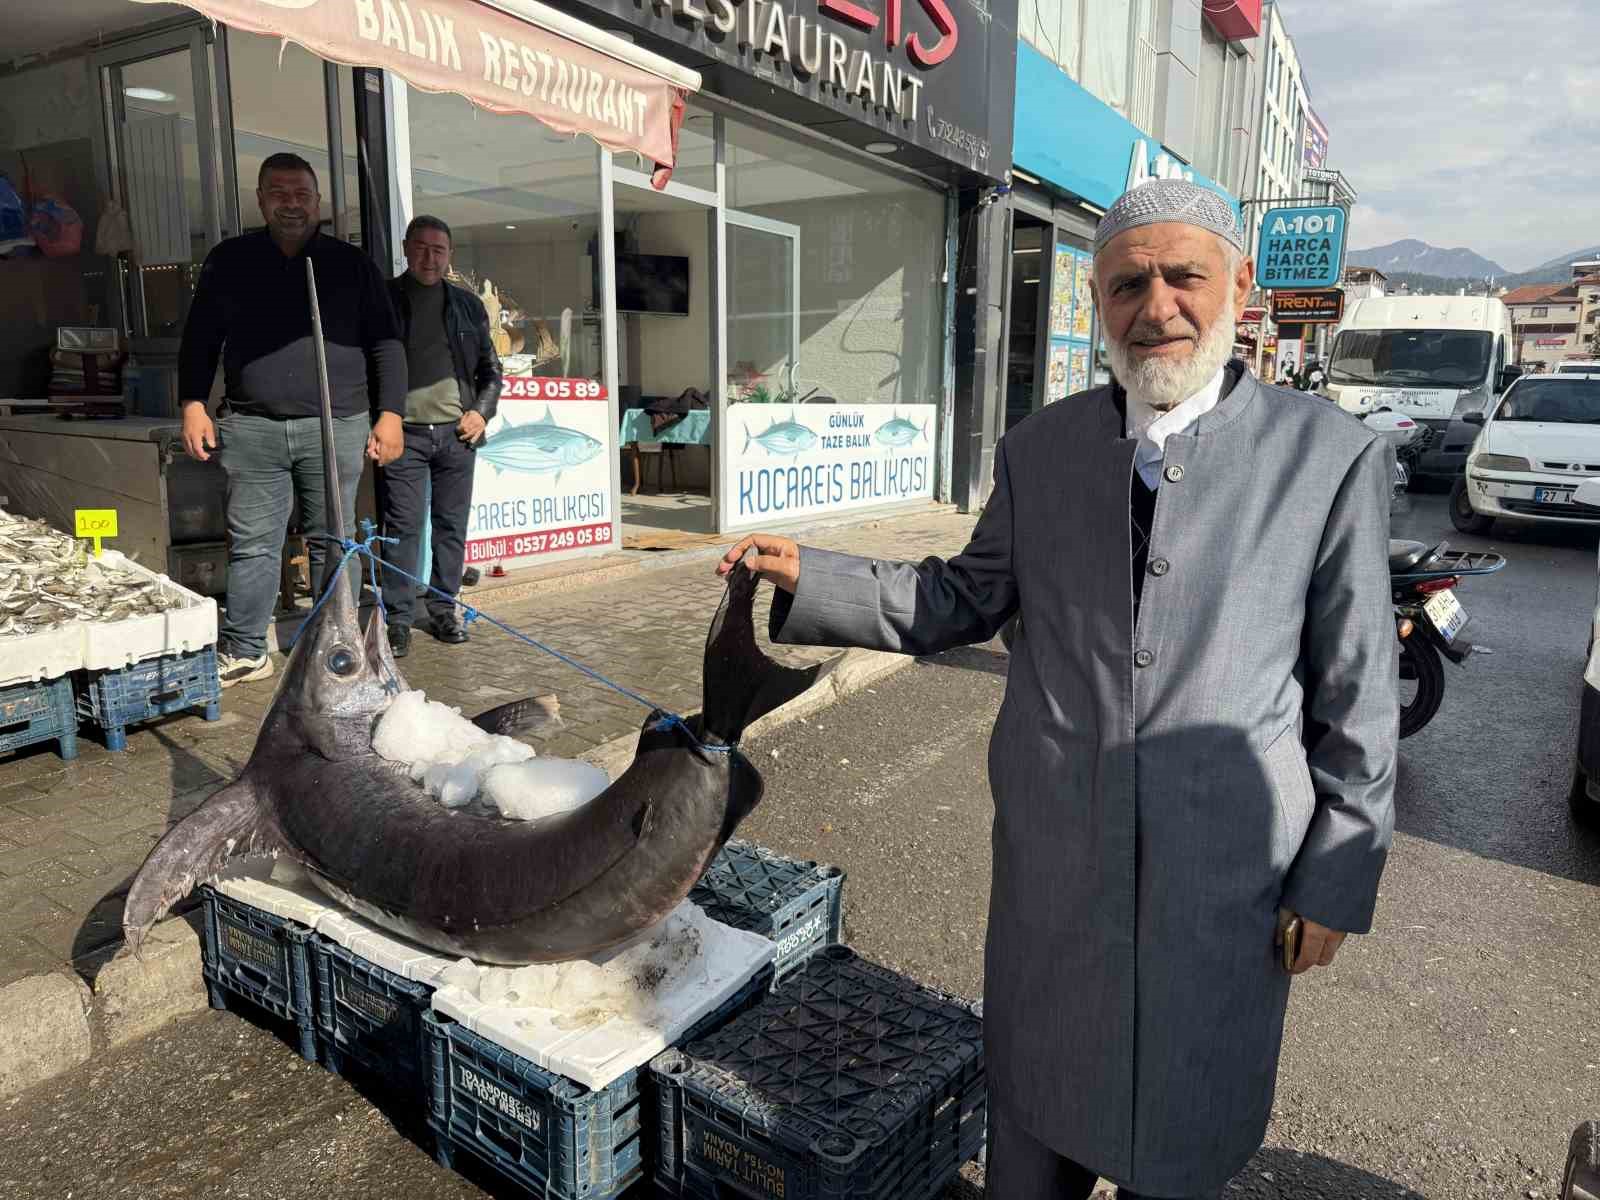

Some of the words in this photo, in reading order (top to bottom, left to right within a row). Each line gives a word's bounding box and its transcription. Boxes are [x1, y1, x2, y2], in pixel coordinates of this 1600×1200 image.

[355, 0, 462, 71] BALIK
[479, 30, 647, 136] RESTAURANT
[662, 0, 923, 121] STAURANT
[1268, 238, 1331, 252] HARCA
[1266, 253, 1330, 266] HARCA
[501, 381, 540, 398] 249
[545, 381, 571, 398] 05
[575, 381, 600, 398] 89
[829, 411, 865, 428] GÜNLÜK
[821, 435, 844, 449] TAZE
[846, 433, 871, 448] BALIK
[850, 456, 928, 499] BALIKÇISI
[1543, 491, 1557, 502] 27
[532, 493, 604, 524] BALIKÇISI
[514, 534, 547, 554] 0537
[549, 531, 575, 549] 249
[577, 528, 593, 544] 05
[595, 526, 611, 542] 89
